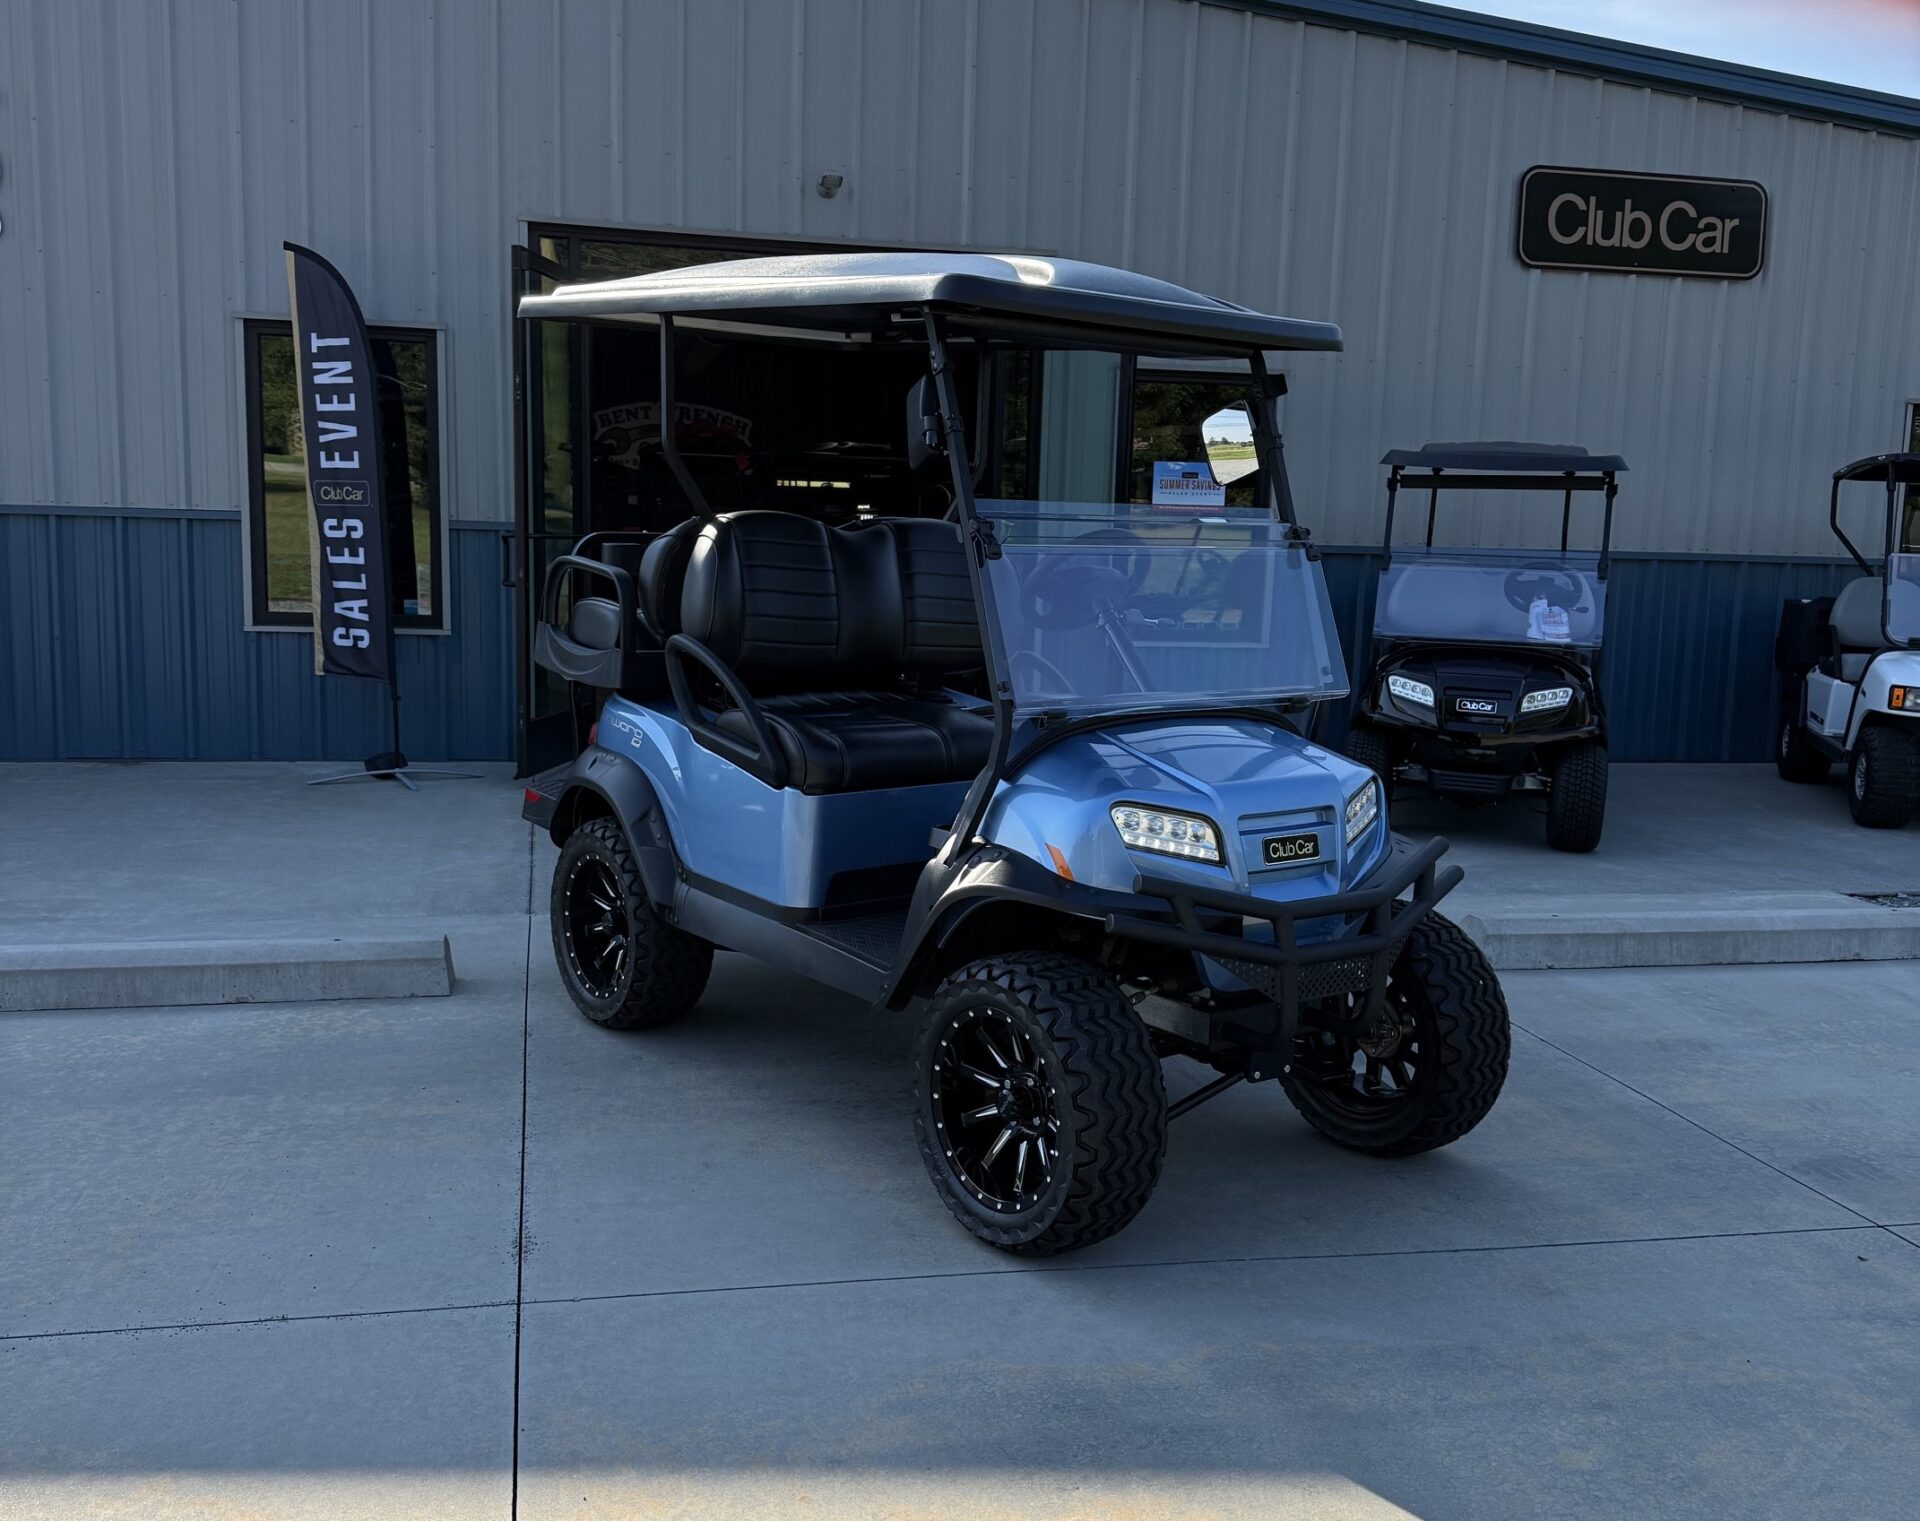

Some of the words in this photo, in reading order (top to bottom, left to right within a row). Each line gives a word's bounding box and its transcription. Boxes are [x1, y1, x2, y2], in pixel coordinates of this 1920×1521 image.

[1547, 193, 1653, 249] Club
[1659, 200, 1740, 254] Car
[311, 332, 360, 468] EVENT
[600, 406, 653, 428] BENT
[1159, 479, 1190, 490] SUMMER
[323, 518, 370, 649] SALES
[1269, 841, 1296, 858] Club
[1295, 839, 1315, 854] Car
